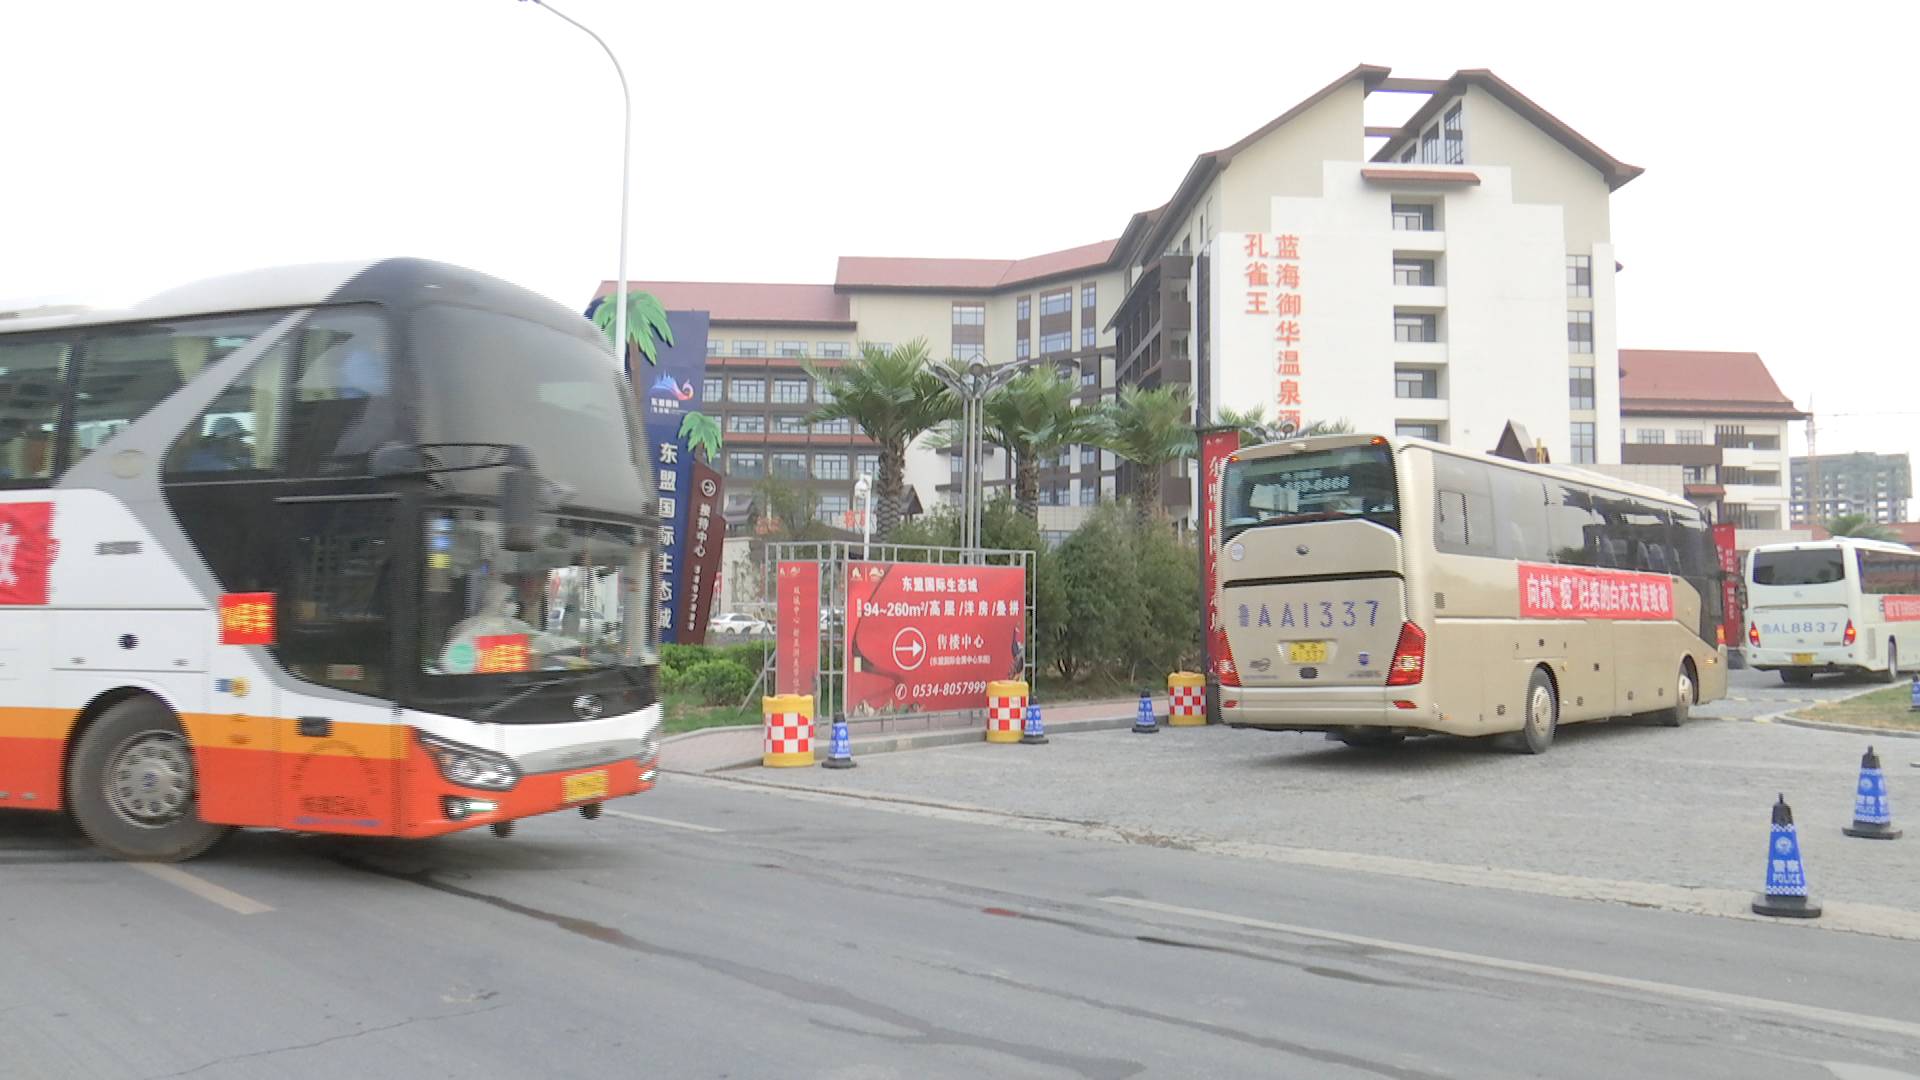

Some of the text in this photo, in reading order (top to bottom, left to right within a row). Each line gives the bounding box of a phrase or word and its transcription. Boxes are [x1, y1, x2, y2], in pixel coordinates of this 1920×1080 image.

[1244, 233, 1270, 316] 孔雀王
[901, 576, 979, 594] 东盟国际生态城
[936, 633, 985, 652] 售楼中心
[912, 681, 987, 699] 0534-8057999
[1772, 873, 1802, 884] POLICE
